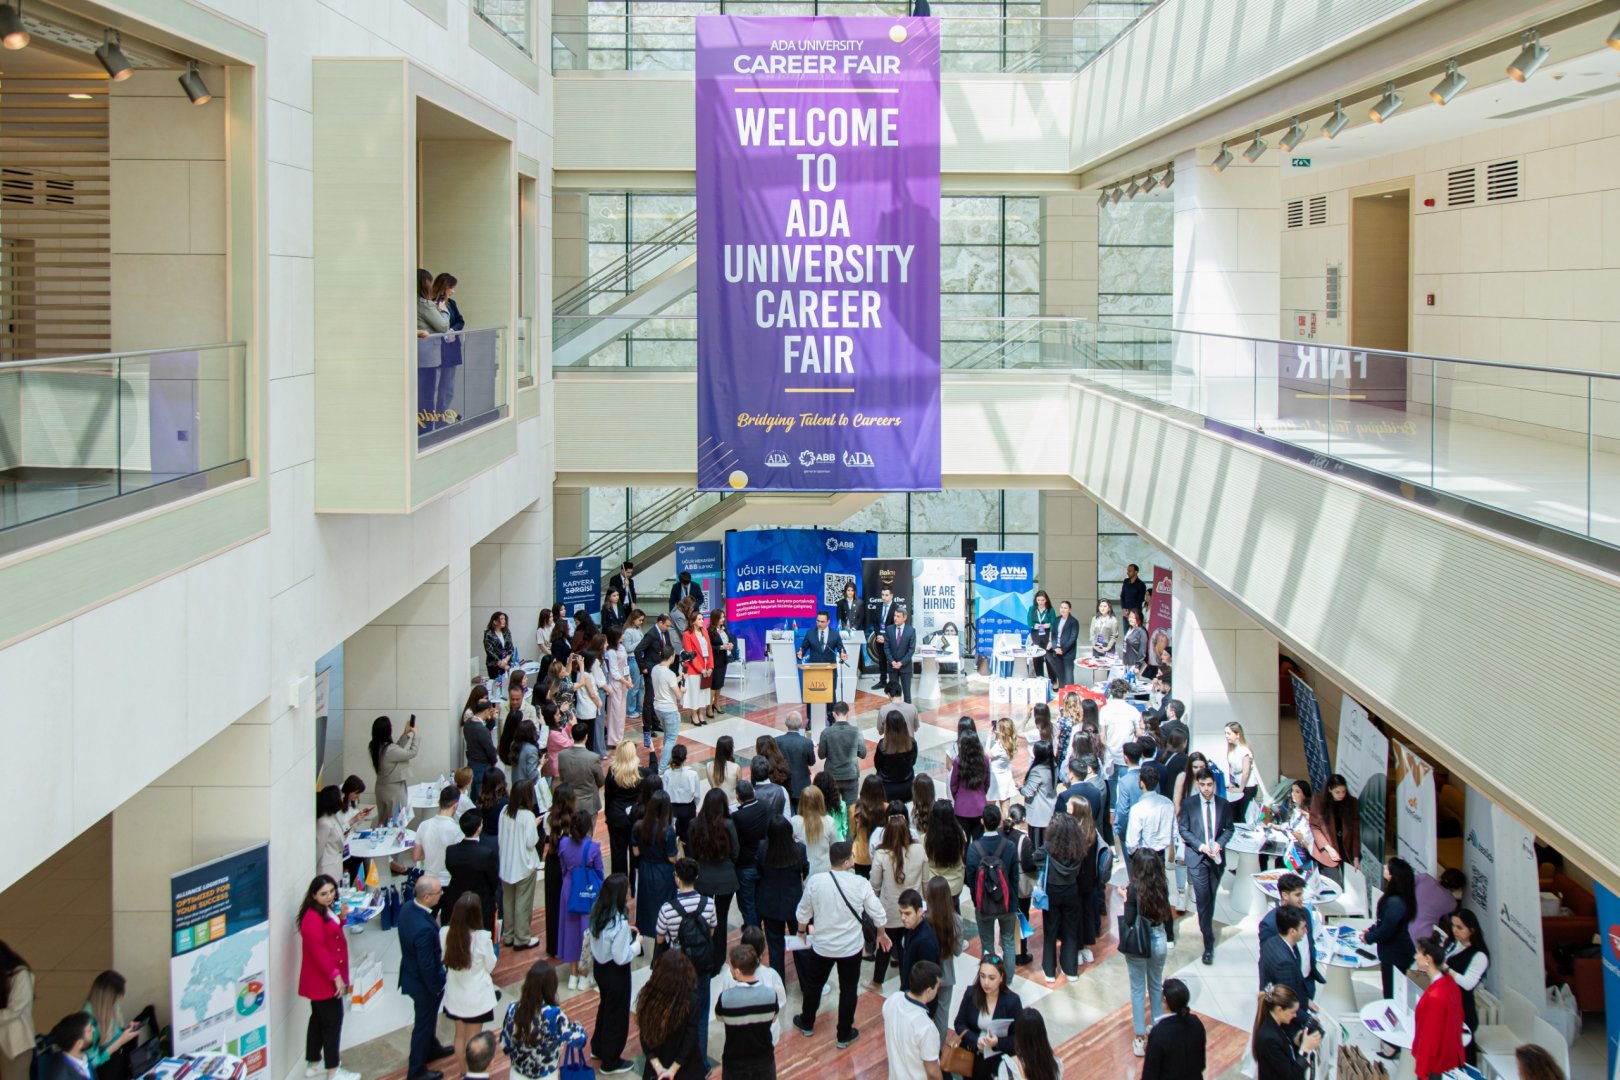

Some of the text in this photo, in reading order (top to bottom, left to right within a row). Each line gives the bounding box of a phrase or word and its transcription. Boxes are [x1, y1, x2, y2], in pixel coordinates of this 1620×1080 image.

[770, 40, 864, 50] ADA UNIVERSITY
[734, 55, 900, 74] CAREER FAIR
[735, 107, 899, 147] WELCOME
[796, 153, 836, 192] TO
[786, 200, 850, 237] ADA
[724, 244, 914, 283] UNIVERSITY
[756, 290, 882, 328] CAREER
[784, 336, 854, 374] FAIR
[737, 412, 902, 432] Bridging Talent to Careers
[768, 454, 788, 463] ADA
[848, 452, 874, 465] ADA
[737, 563, 822, 577] UĞUR HEKAYƏNİ
[563, 578, 595, 588] KARYERA
[736, 579, 804, 592] ABB İLƏ YAZ!
[923, 586, 955, 596] WE ARE
[923, 598, 956, 610] HIRING
[176, 883, 231, 908] OPTIMIZED FOR
[176, 892, 229, 916] YOUR SUCCESS
